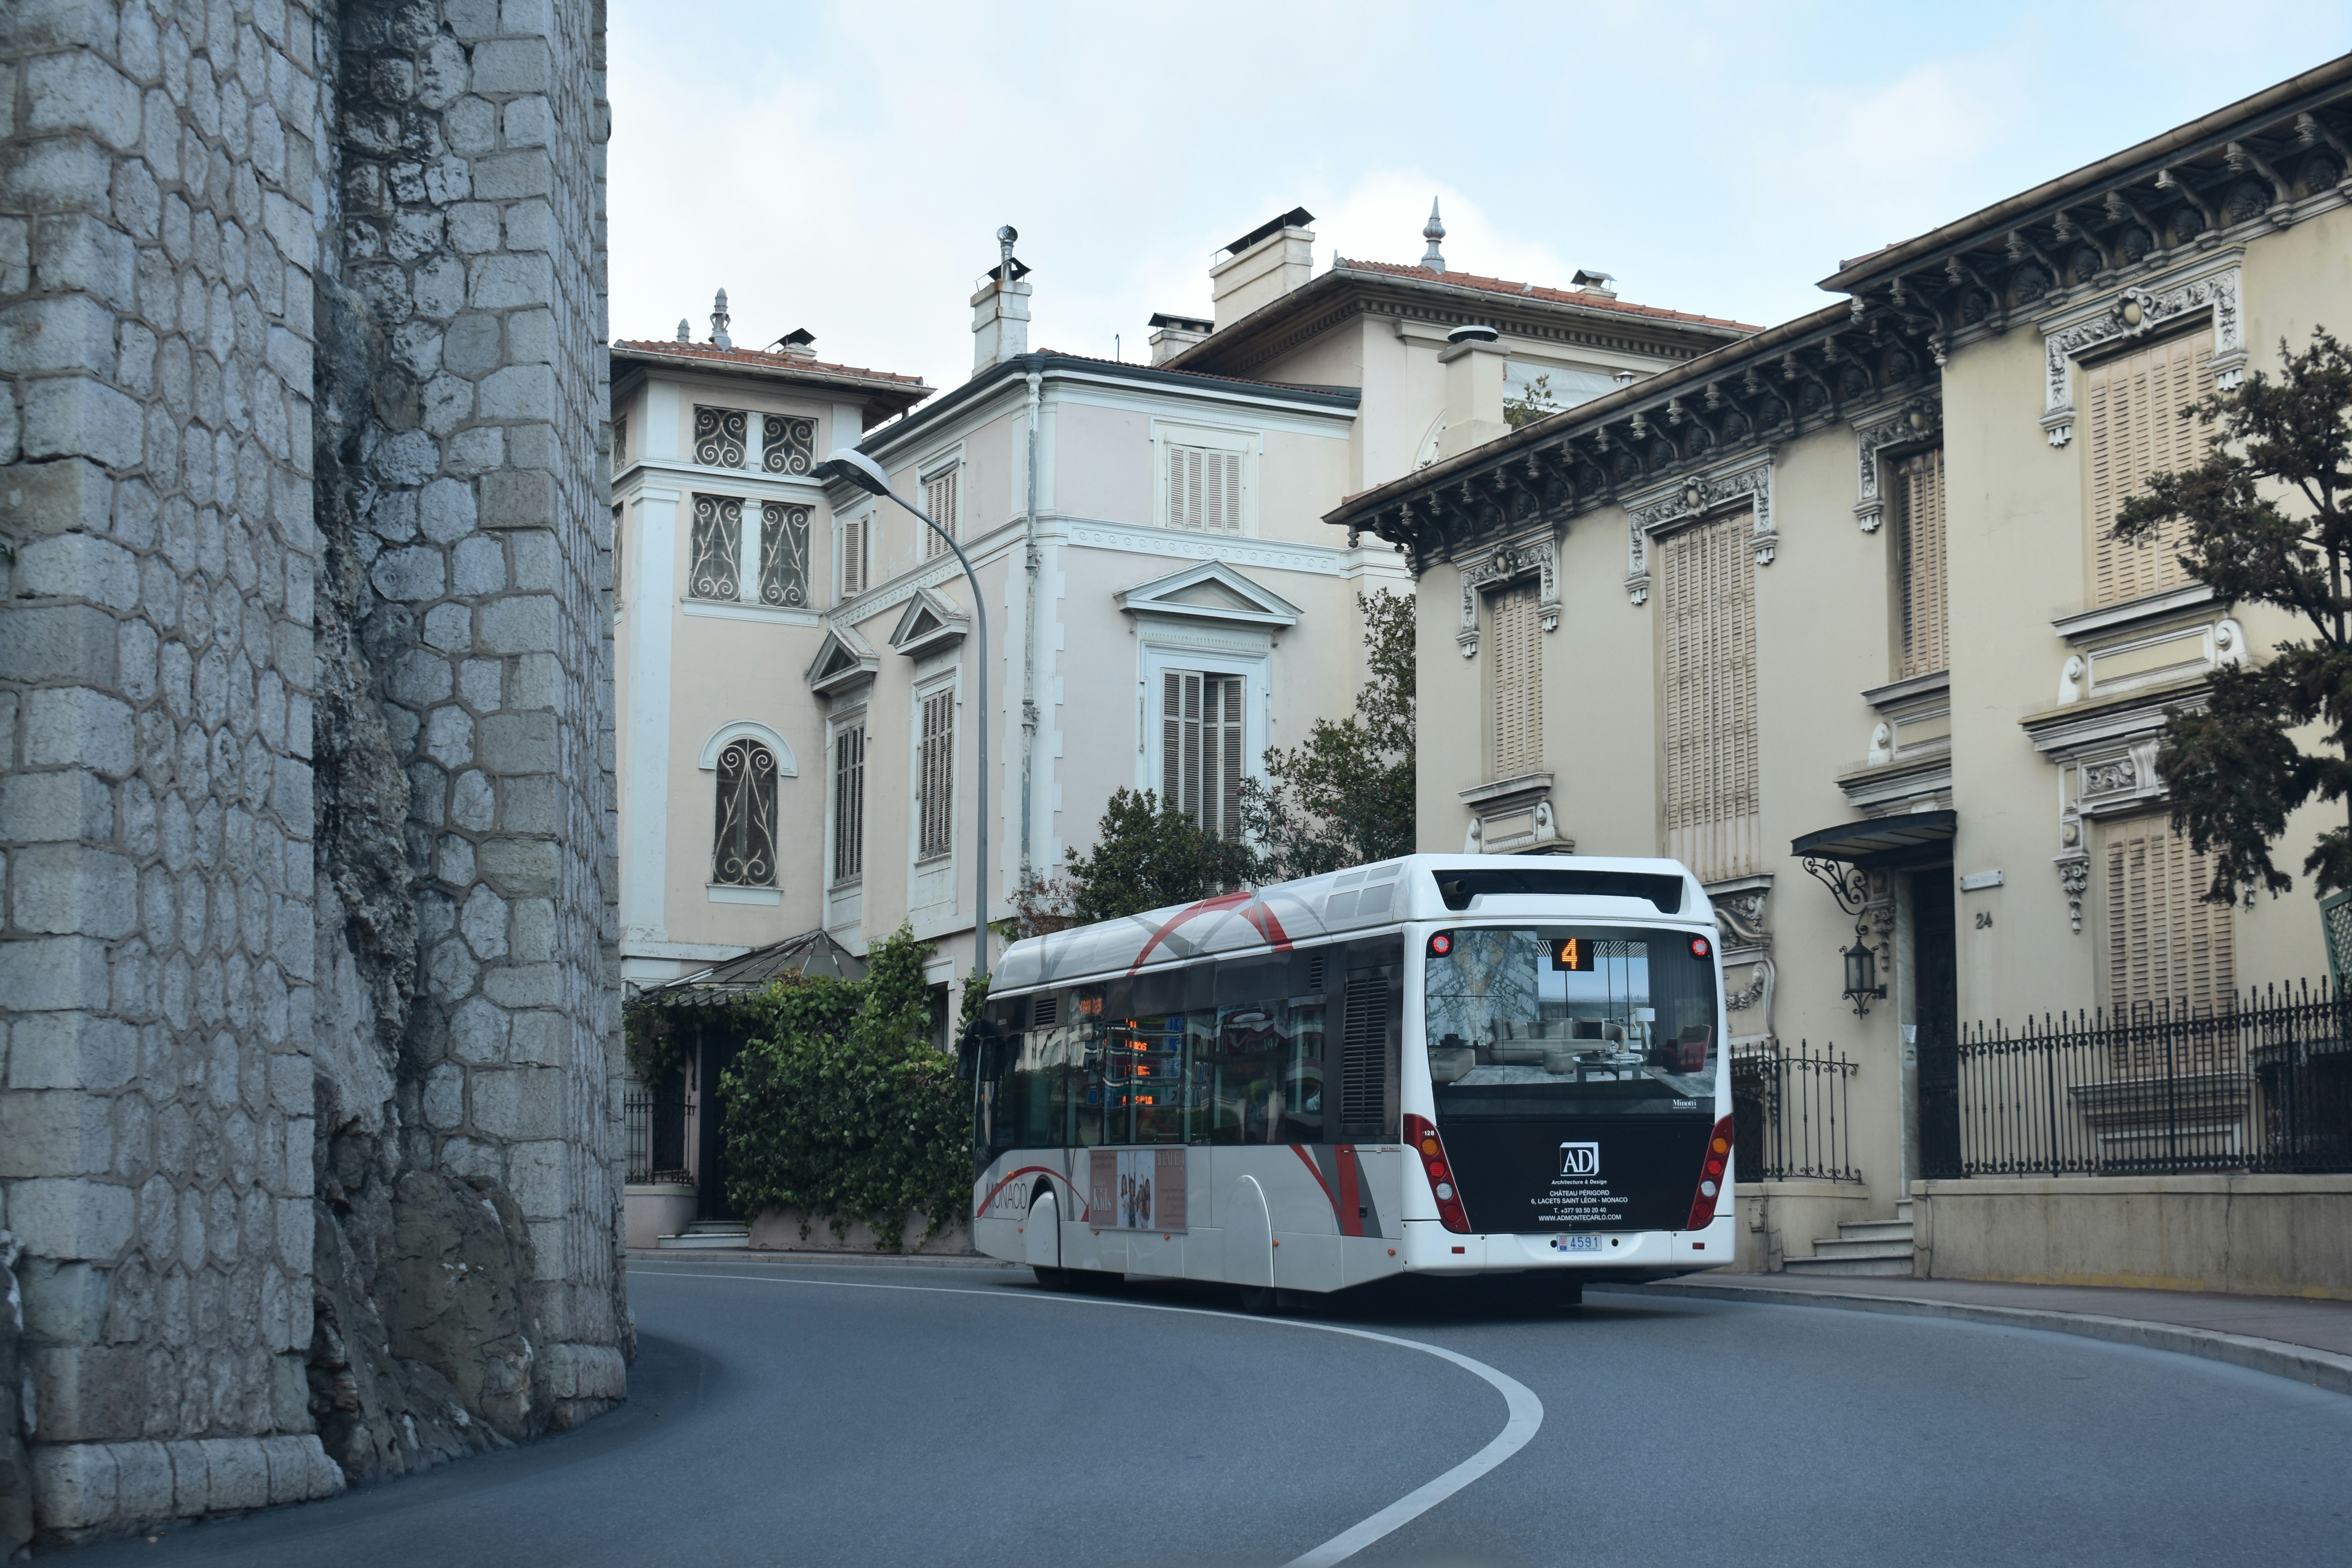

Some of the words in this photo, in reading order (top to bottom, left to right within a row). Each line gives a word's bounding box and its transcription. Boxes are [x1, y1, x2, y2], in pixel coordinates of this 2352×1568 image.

[1976, 911, 1993, 929] 24
[1562, 939, 1577, 969] 4
[1563, 1149, 1593, 1172] AD
[986, 1183, 1027, 1209] MONACO
[1094, 1188, 1111, 1211] Kids
[1570, 1236, 1597, 1247] 4591
